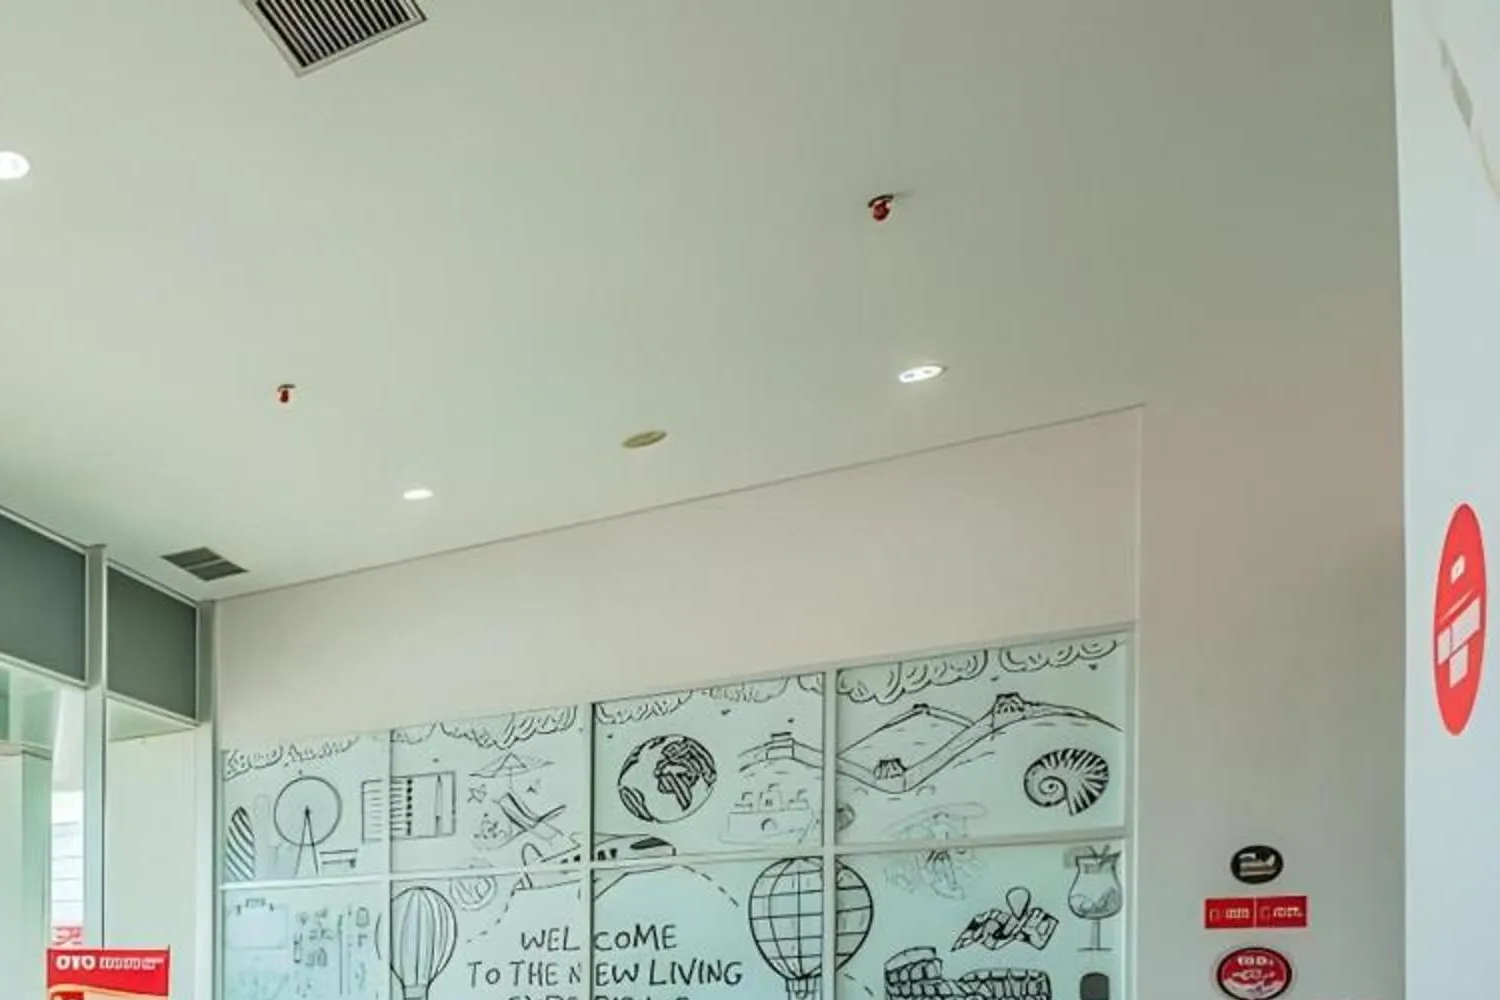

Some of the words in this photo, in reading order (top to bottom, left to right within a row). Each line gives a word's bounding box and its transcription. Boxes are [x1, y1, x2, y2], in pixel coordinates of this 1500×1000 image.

[521, 924, 678, 951] WELCOME
[510, 960, 558, 986] THE
[568, 961, 639, 986] NEW
[649, 958, 743, 986] LIVING
